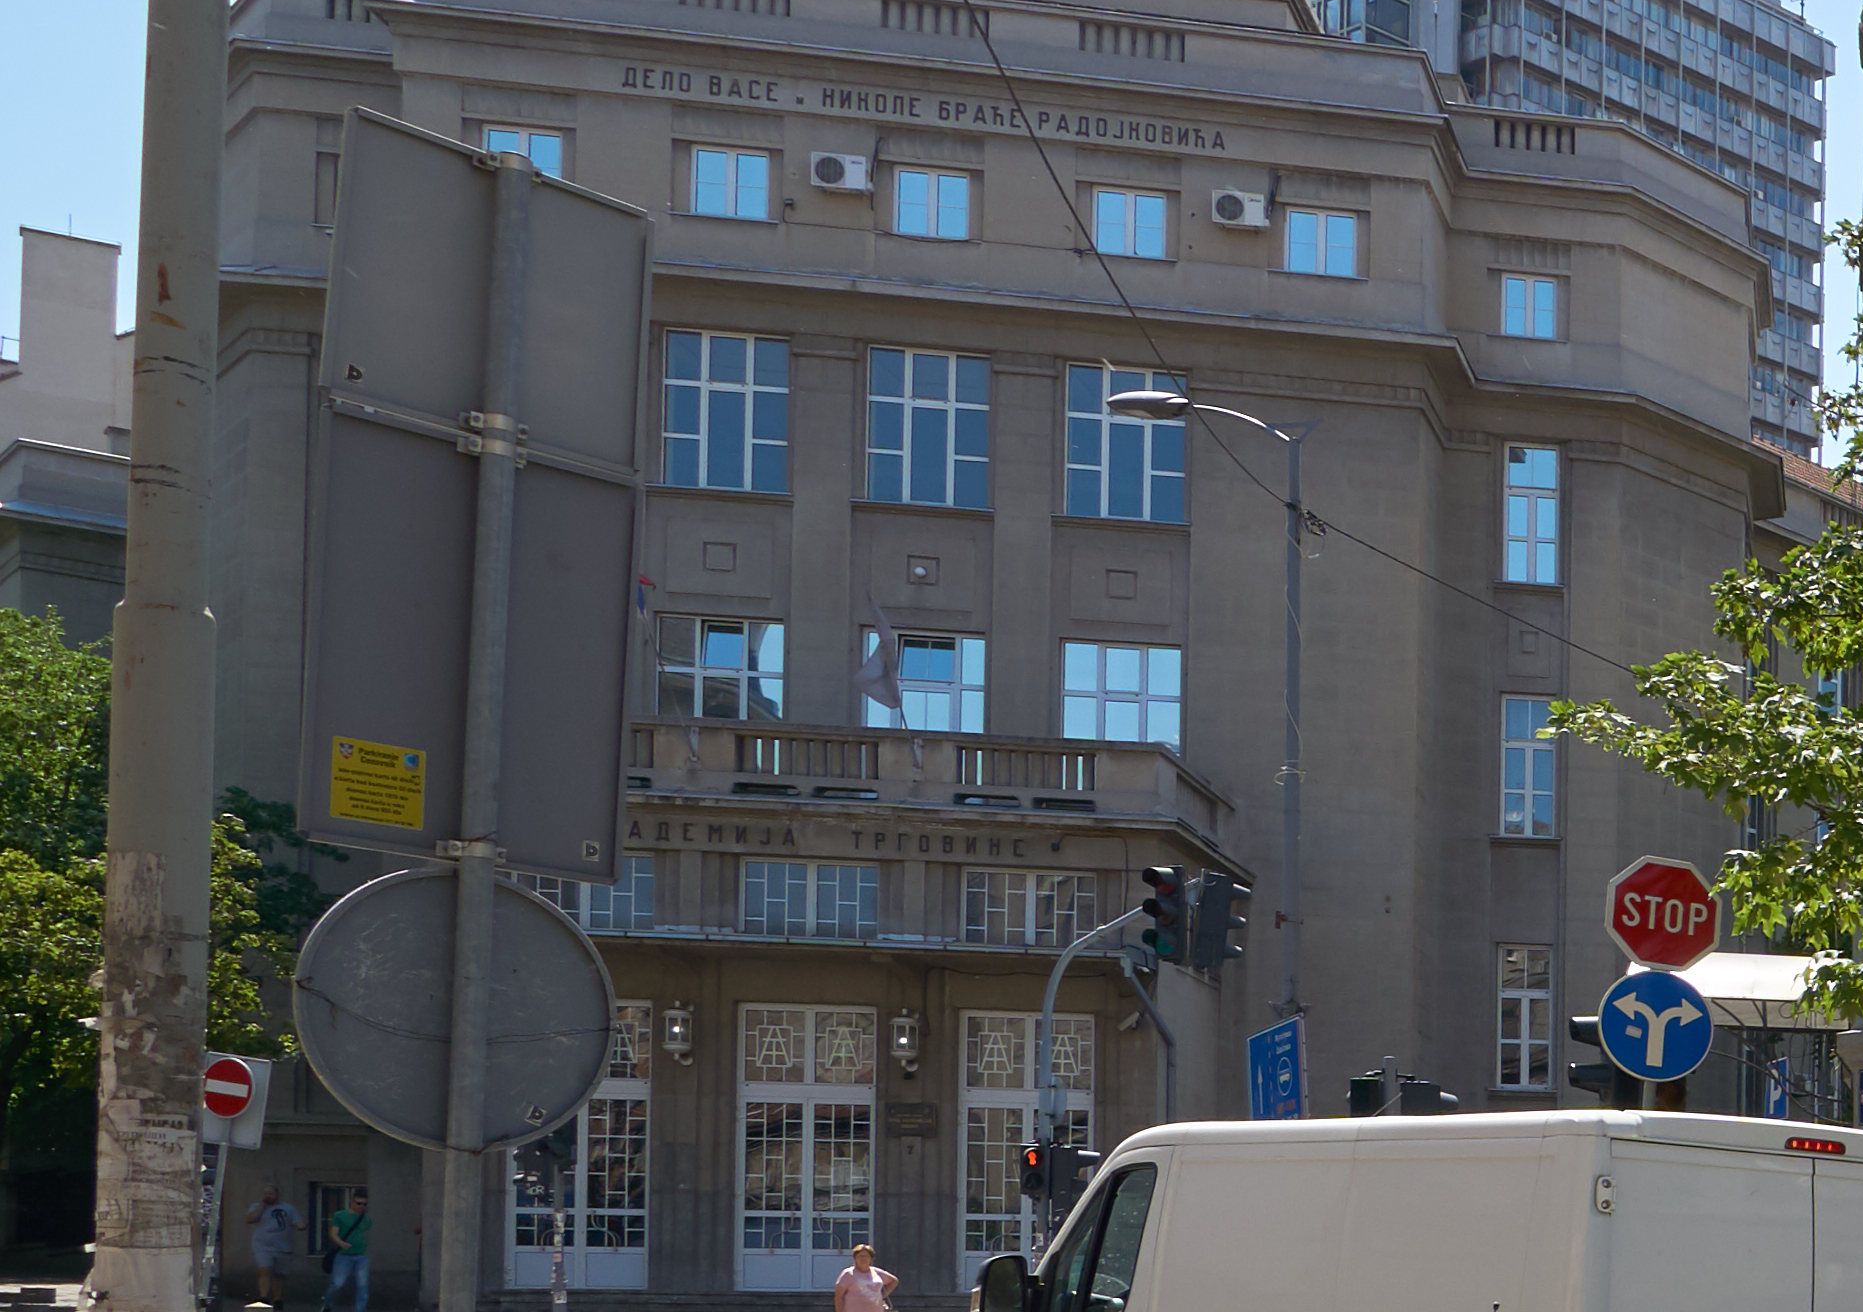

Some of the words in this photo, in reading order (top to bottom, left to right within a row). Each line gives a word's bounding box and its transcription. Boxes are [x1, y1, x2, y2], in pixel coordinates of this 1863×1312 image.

[621, 66, 692, 93] ДЕЛО
[708, 75, 779, 103] ВАСЕ
[821, 87, 922, 118] НИКОЛЕ
[938, 100, 1022, 128] БРАЋЕ
[1038, 111, 1226, 151] РАДОЈКОВИЋА
[628, 820, 796, 847] АДЕМИЈА
[851, 830, 1026, 858] ТРГОВИНЕ
[1621, 891, 1709, 936] STOP
